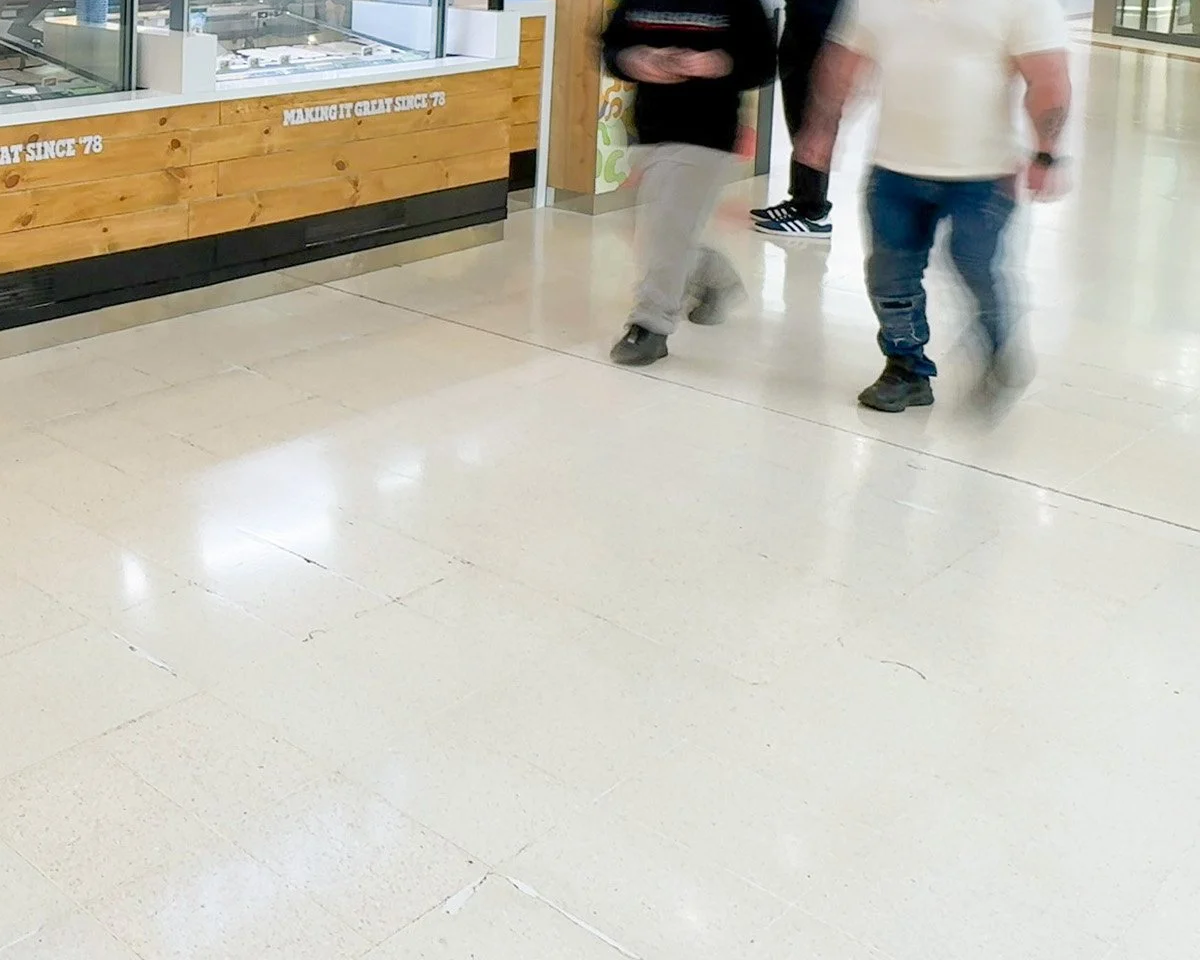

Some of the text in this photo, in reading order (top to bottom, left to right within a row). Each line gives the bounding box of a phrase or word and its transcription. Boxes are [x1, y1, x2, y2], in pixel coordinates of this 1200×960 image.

[283, 104, 338, 127] MAKING
[338, 102, 354, 119] IT
[354, 96, 394, 117] GREAT
[394, 93, 428, 112] SINCE
[25, 138, 77, 162] SINCE
